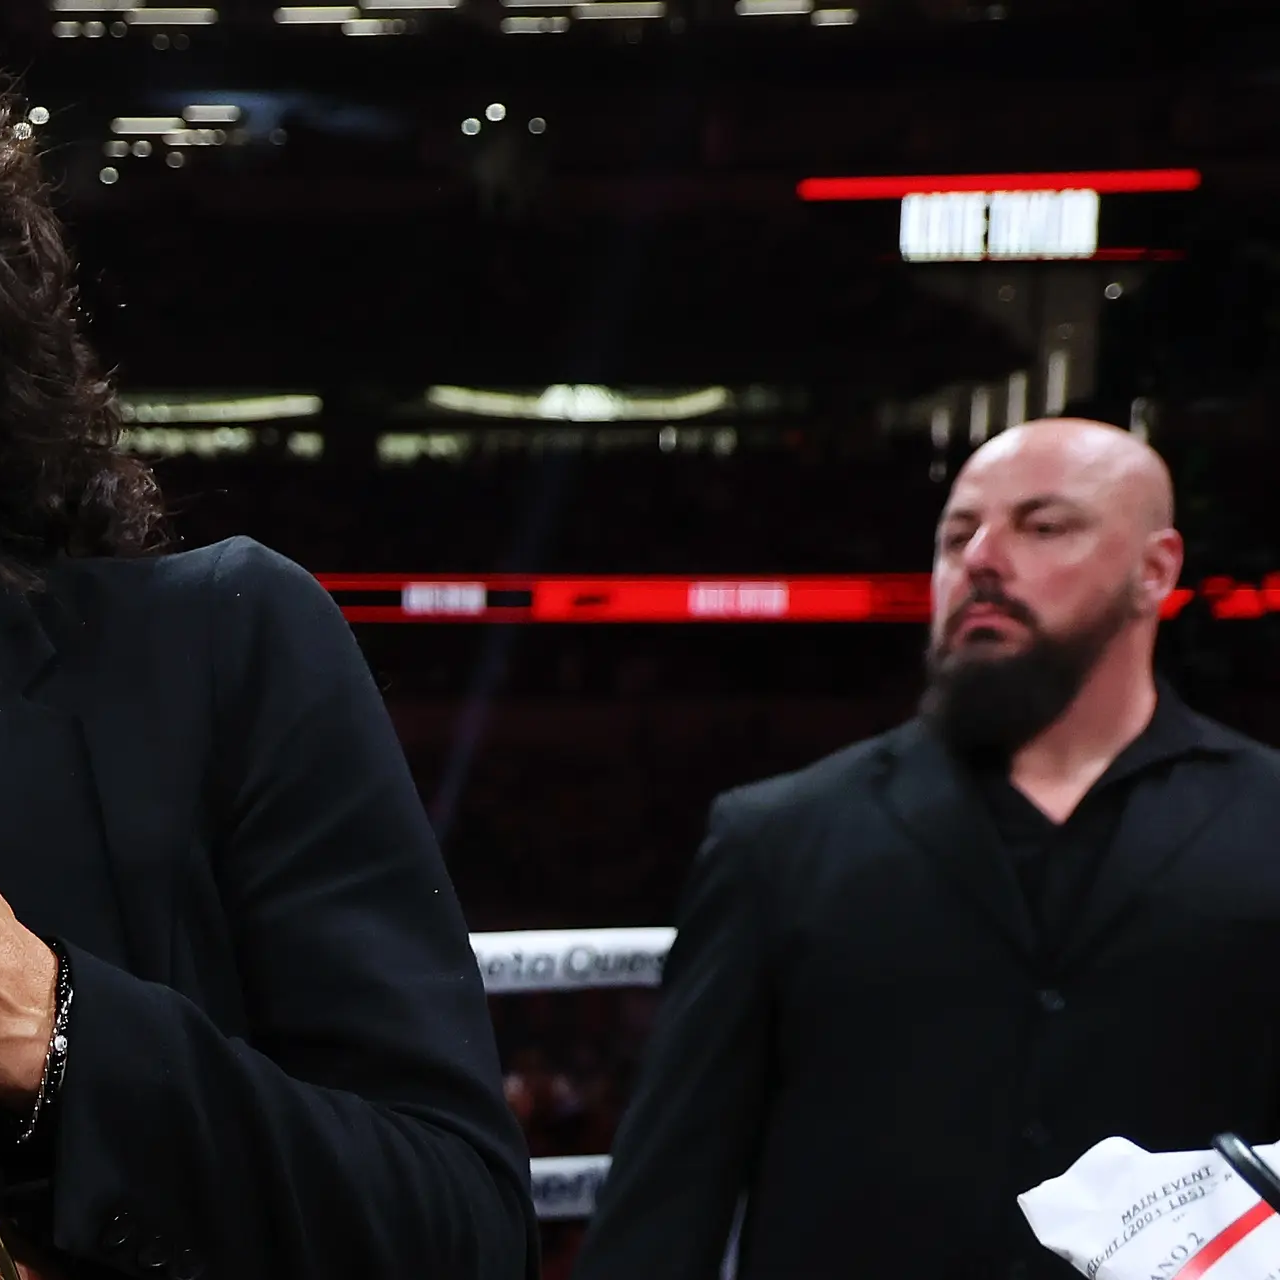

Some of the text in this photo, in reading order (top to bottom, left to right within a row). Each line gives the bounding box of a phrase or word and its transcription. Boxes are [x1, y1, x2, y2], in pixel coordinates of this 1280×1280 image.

[1121, 1165, 1214, 1225] MAIN EVENT
[1188, 1232, 1205, 1246] 2
